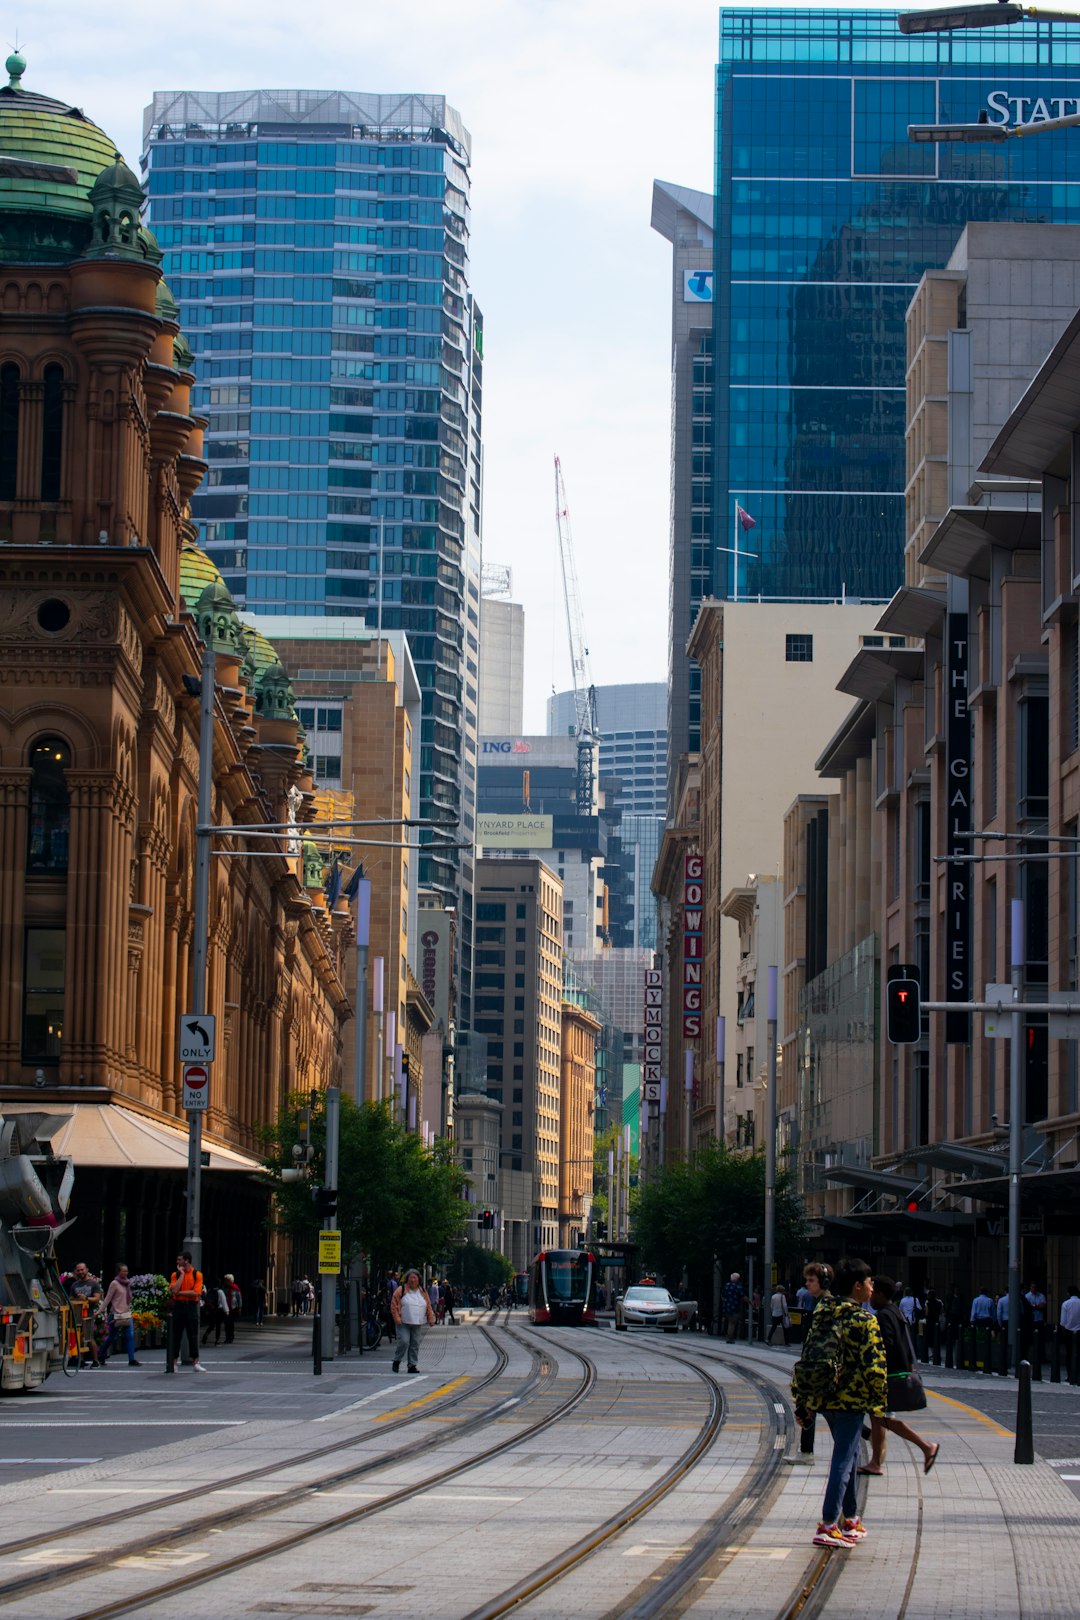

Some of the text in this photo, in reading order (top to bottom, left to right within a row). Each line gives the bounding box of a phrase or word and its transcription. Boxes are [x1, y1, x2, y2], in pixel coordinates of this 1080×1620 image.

[987, 91, 1080, 126] STAT
[952, 641, 968, 718] THE
[483, 742, 511, 753] ING
[686, 858, 702, 1036] GOWINGS
[182, 1049, 211, 1057] ONLY
[648, 972, 661, 1098] DYMOCKS
